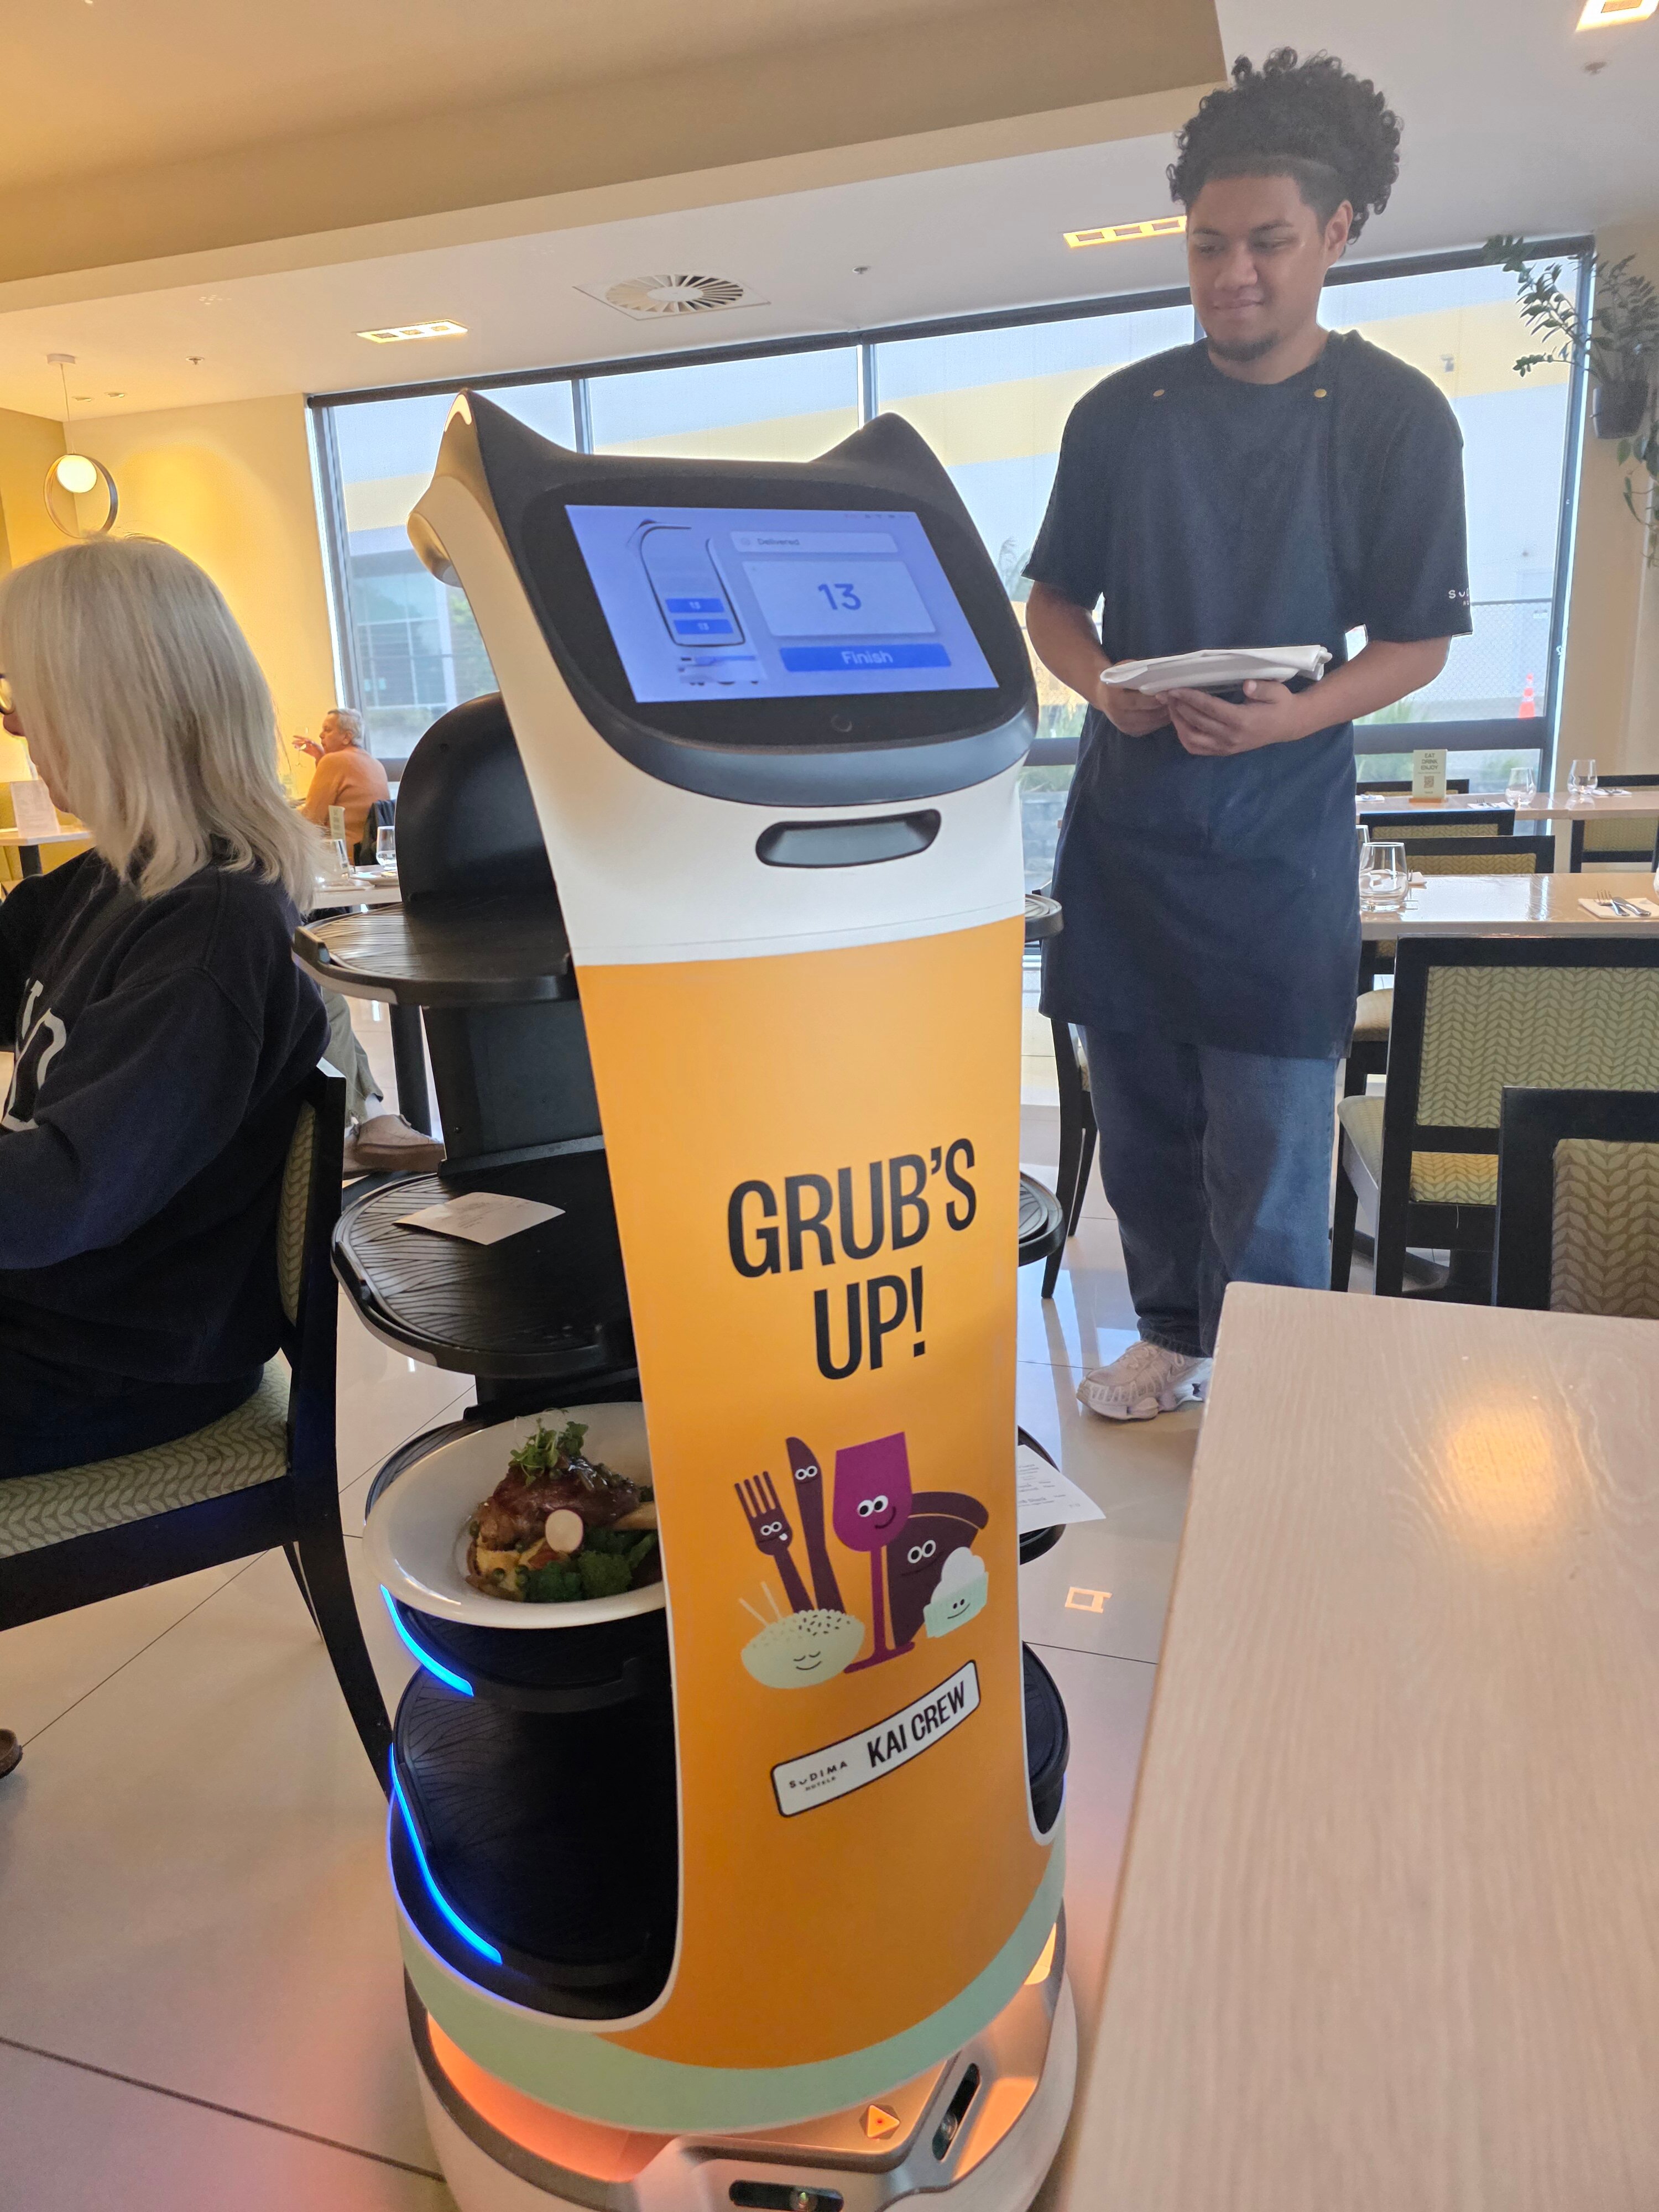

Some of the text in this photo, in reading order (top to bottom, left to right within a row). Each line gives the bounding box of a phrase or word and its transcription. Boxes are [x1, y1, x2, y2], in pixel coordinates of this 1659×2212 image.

[757, 538, 800, 546] Delivered
[818, 583, 862, 610] 13
[841, 650, 894, 664] Finish
[728, 1138, 977, 1278] GRUB'S
[814, 1266, 926, 1380] UP!
[867, 1724, 907, 1768] KAI
[911, 1680, 964, 1741] CREW
